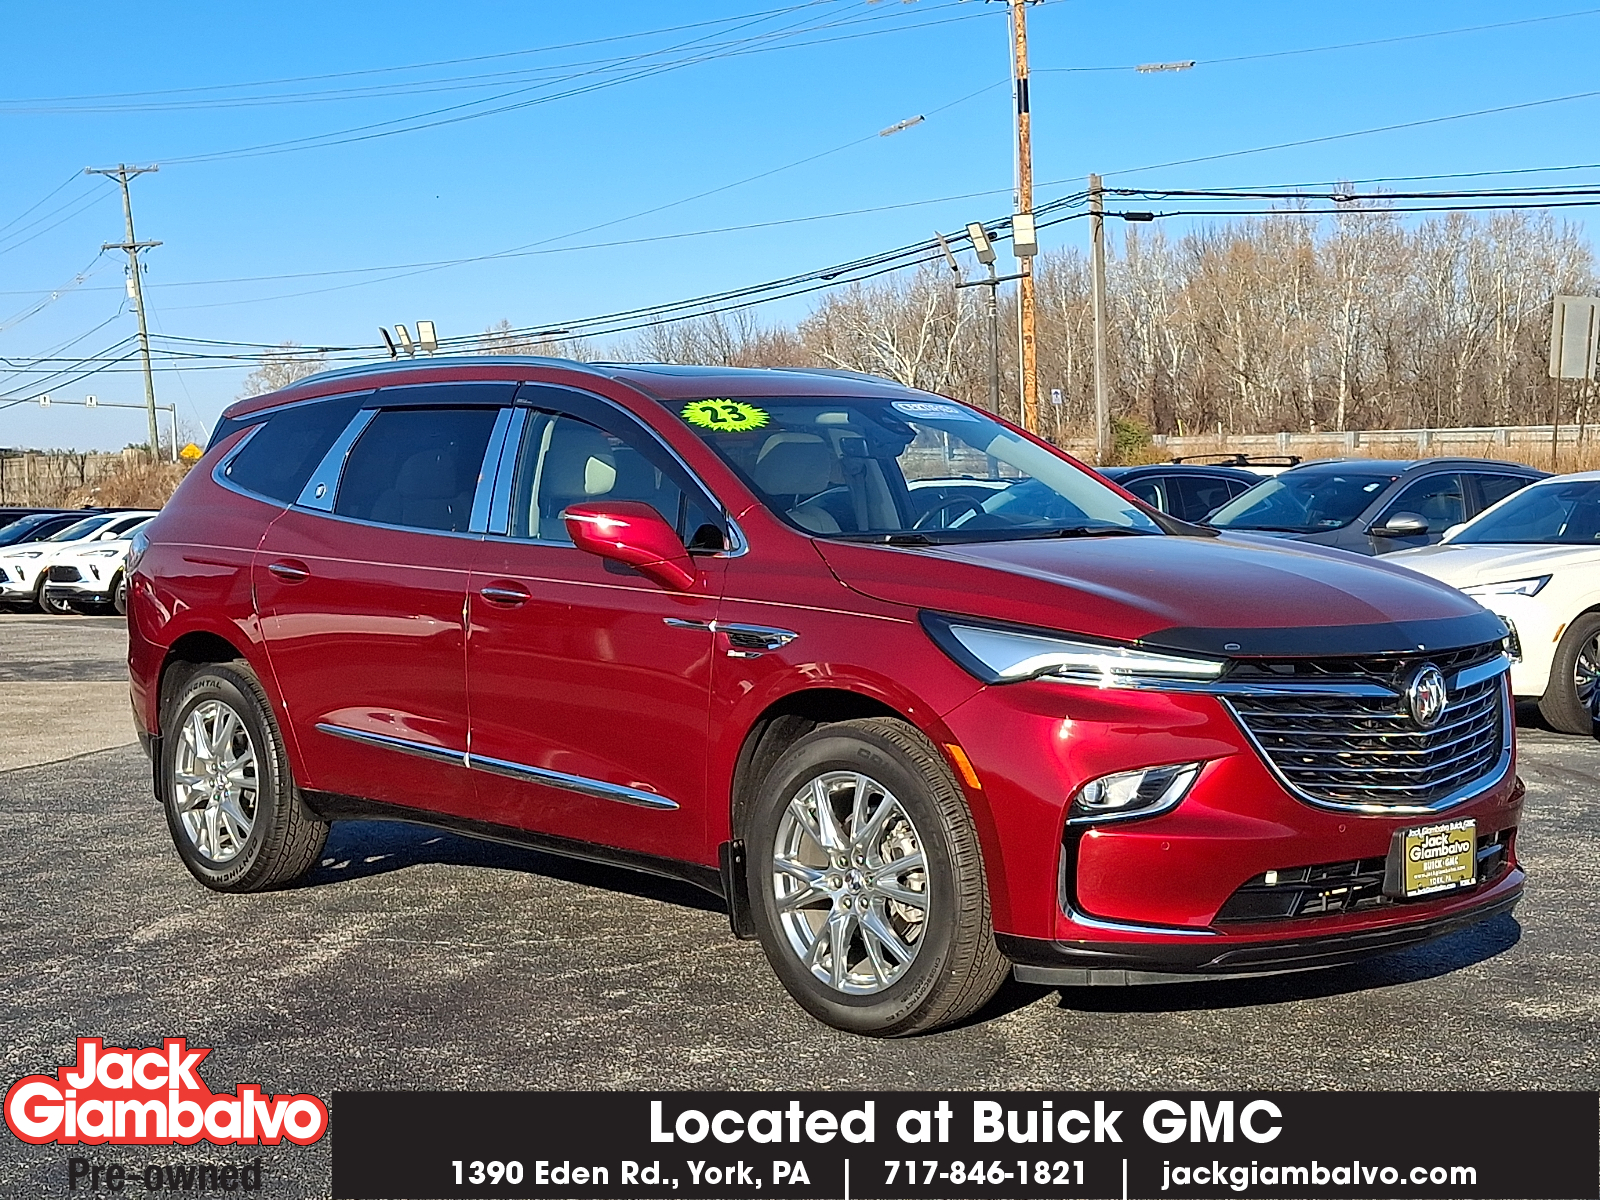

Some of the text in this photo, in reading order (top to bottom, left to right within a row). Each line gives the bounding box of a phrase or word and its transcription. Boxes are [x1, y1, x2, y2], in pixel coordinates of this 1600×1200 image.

[699, 405, 747, 423] 23
[1422, 833, 1449, 849] Jack
[200, 837, 258, 882] CONTINENT
[1410, 841, 1470, 861] Giambalvo
